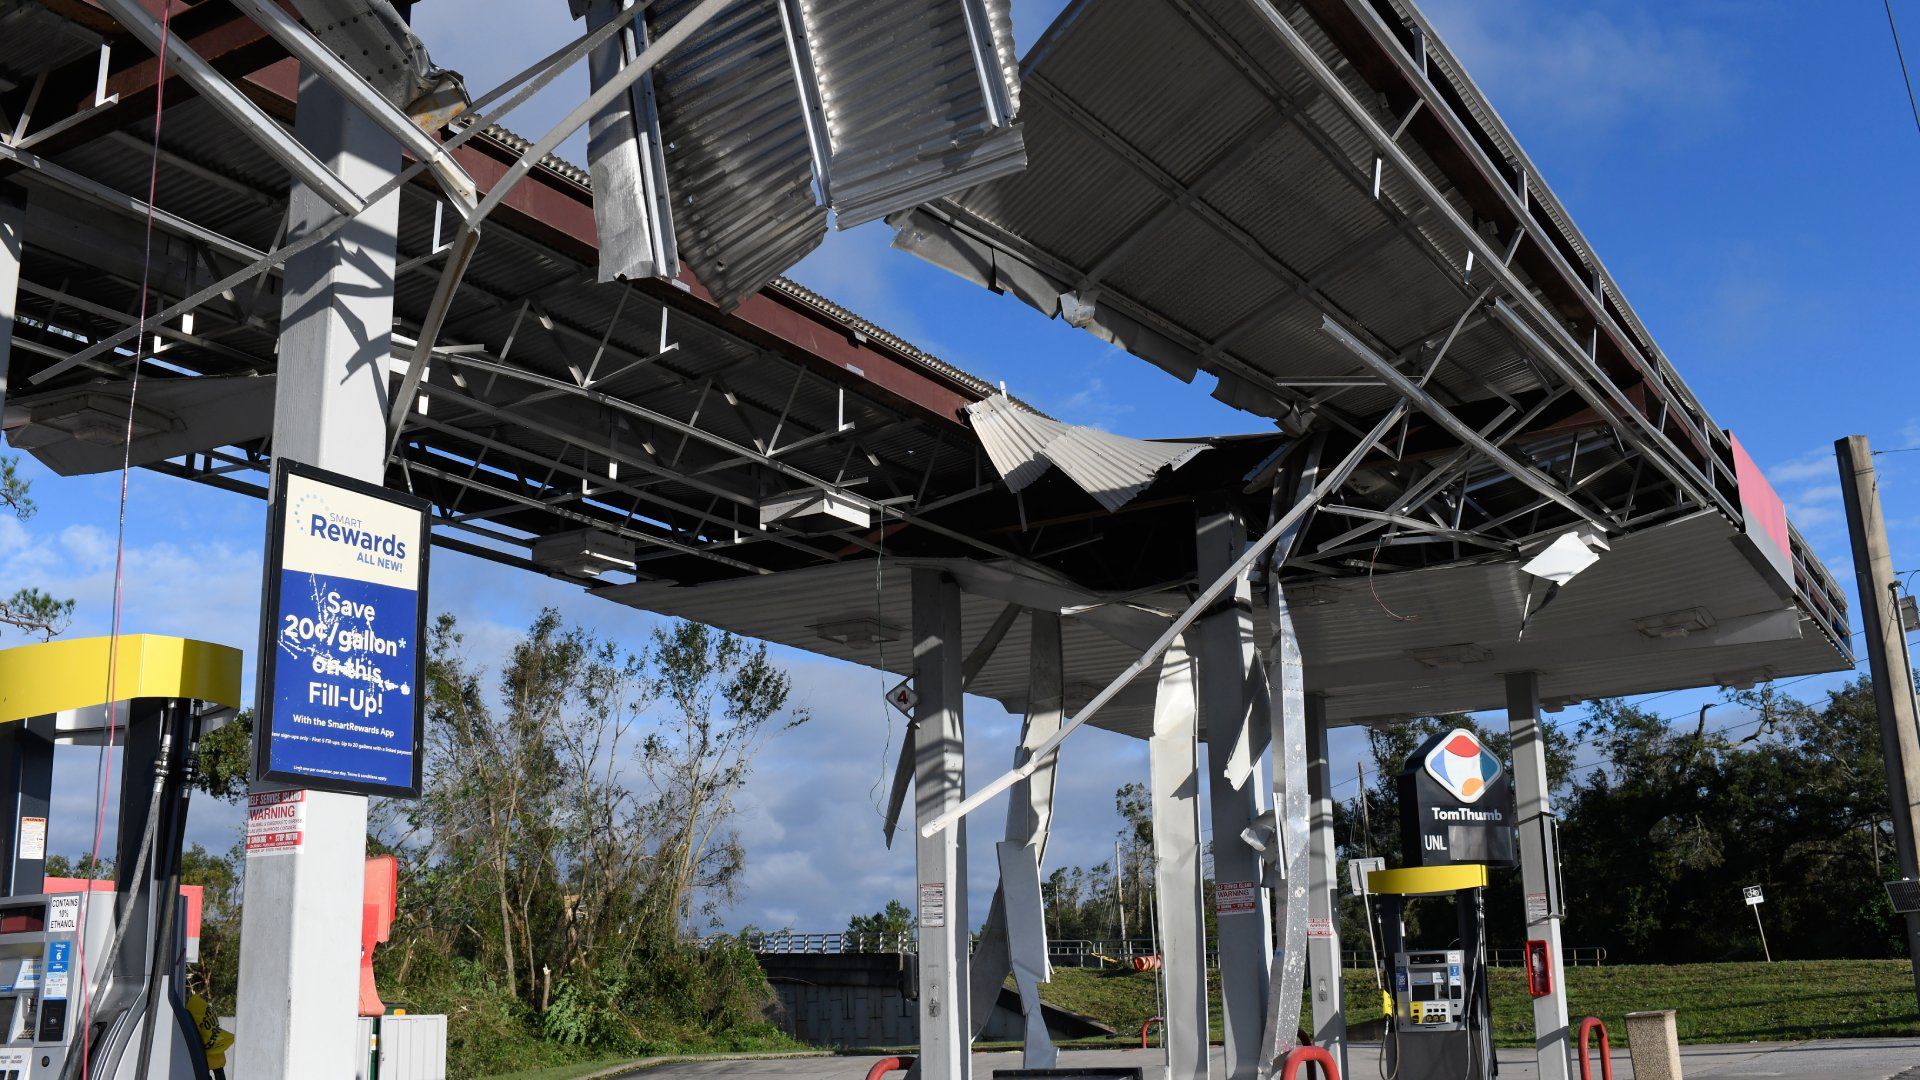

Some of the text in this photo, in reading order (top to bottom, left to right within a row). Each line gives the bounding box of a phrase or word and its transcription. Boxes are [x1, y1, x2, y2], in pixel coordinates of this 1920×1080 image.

[330, 512, 362, 529] SMART
[310, 513, 406, 560] Rewards
[357, 551, 403, 573] ALL NEW!
[327, 591, 375, 621] Save
[344, 657, 382, 683] this
[309, 681, 383, 717] Fill-Up!
[897, 690, 908, 704] 4
[293, 714, 395, 739] With the SmartRewards App
[260, 792, 281, 805] SERVICE
[250, 805, 296, 821] WARNING
[1431, 806, 1503, 821] TomThumb
[1424, 834, 1448, 851] UNL
[1217, 889, 1250, 898] WARNING
[52, 898, 78, 908] CONTAINS
[50, 919, 75, 929] ETHANOL
